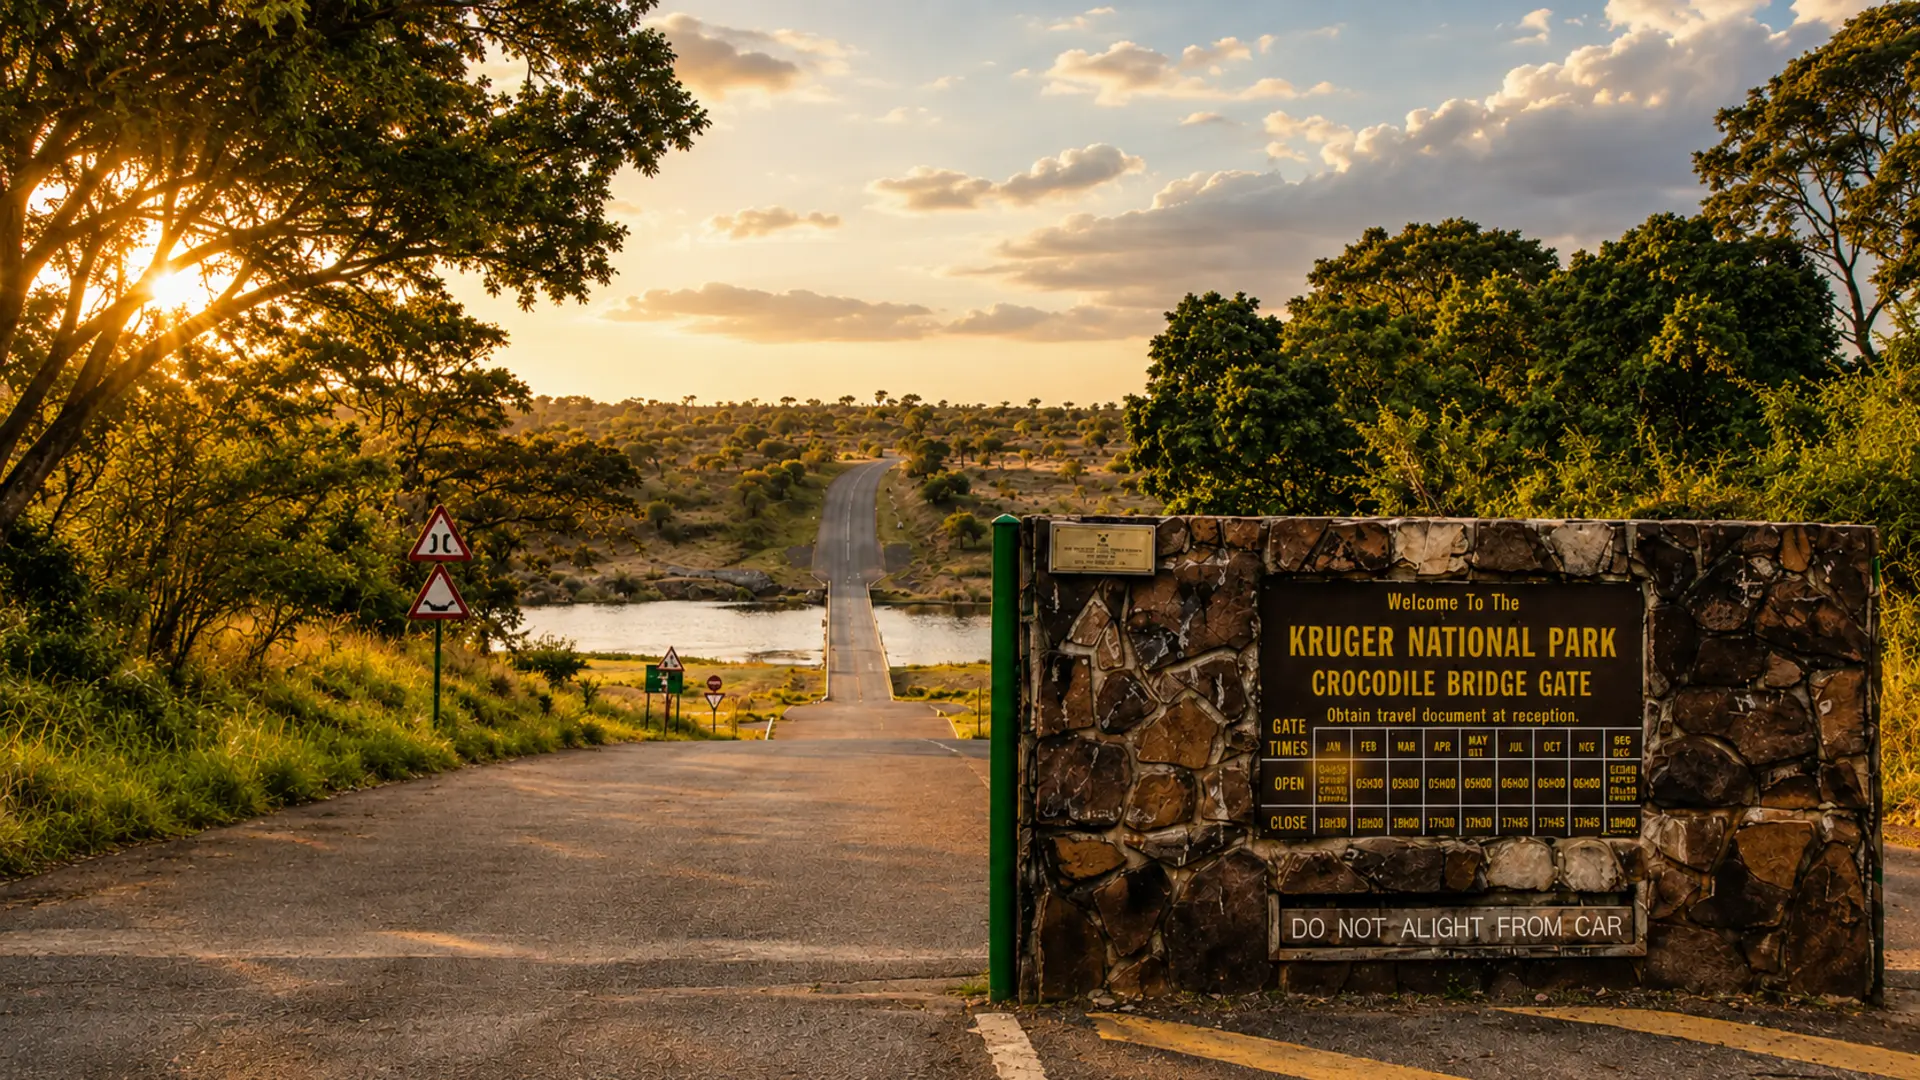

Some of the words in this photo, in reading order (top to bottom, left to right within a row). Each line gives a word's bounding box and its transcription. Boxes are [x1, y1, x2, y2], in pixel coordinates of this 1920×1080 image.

[1387, 592, 1458, 611] Welcome
[1465, 593, 1484, 611] To
[1491, 593, 1520, 611] The
[1289, 625, 1394, 657] KRUGER
[1408, 626, 1536, 658] NATIONAL
[1548, 627, 1617, 658] PARK
[1312, 669, 1436, 697] CROCODILE
[1447, 670, 1527, 697] BRIDGE
[1538, 670, 1592, 697] GATE
[1327, 707, 1371, 723] Obtain
[1377, 707, 1416, 723] travel
[1422, 707, 1487, 723] document
[1492, 708, 1506, 723] at
[1512, 707, 1579, 726] reception.
[1272, 718, 1307, 735] GATE
[1269, 740, 1308, 756] TIMES
[1325, 741, 1341, 753] JAN
[1360, 741, 1377, 752] FEB
[1433, 741, 1451, 752] APR
[1508, 741, 1524, 753] JUL
[1543, 741, 1561, 752] OCT
[1468, 735, 1488, 745] MAY
[1274, 776, 1305, 791] OPEN
[1270, 815, 1307, 830] CLOSE
[1292, 917, 1325, 939] DO
[1338, 917, 1387, 938] NOT
[1400, 916, 1485, 938] ALIGHT
[1497, 916, 1562, 938] FROM
[1574, 915, 1622, 937] CAR
